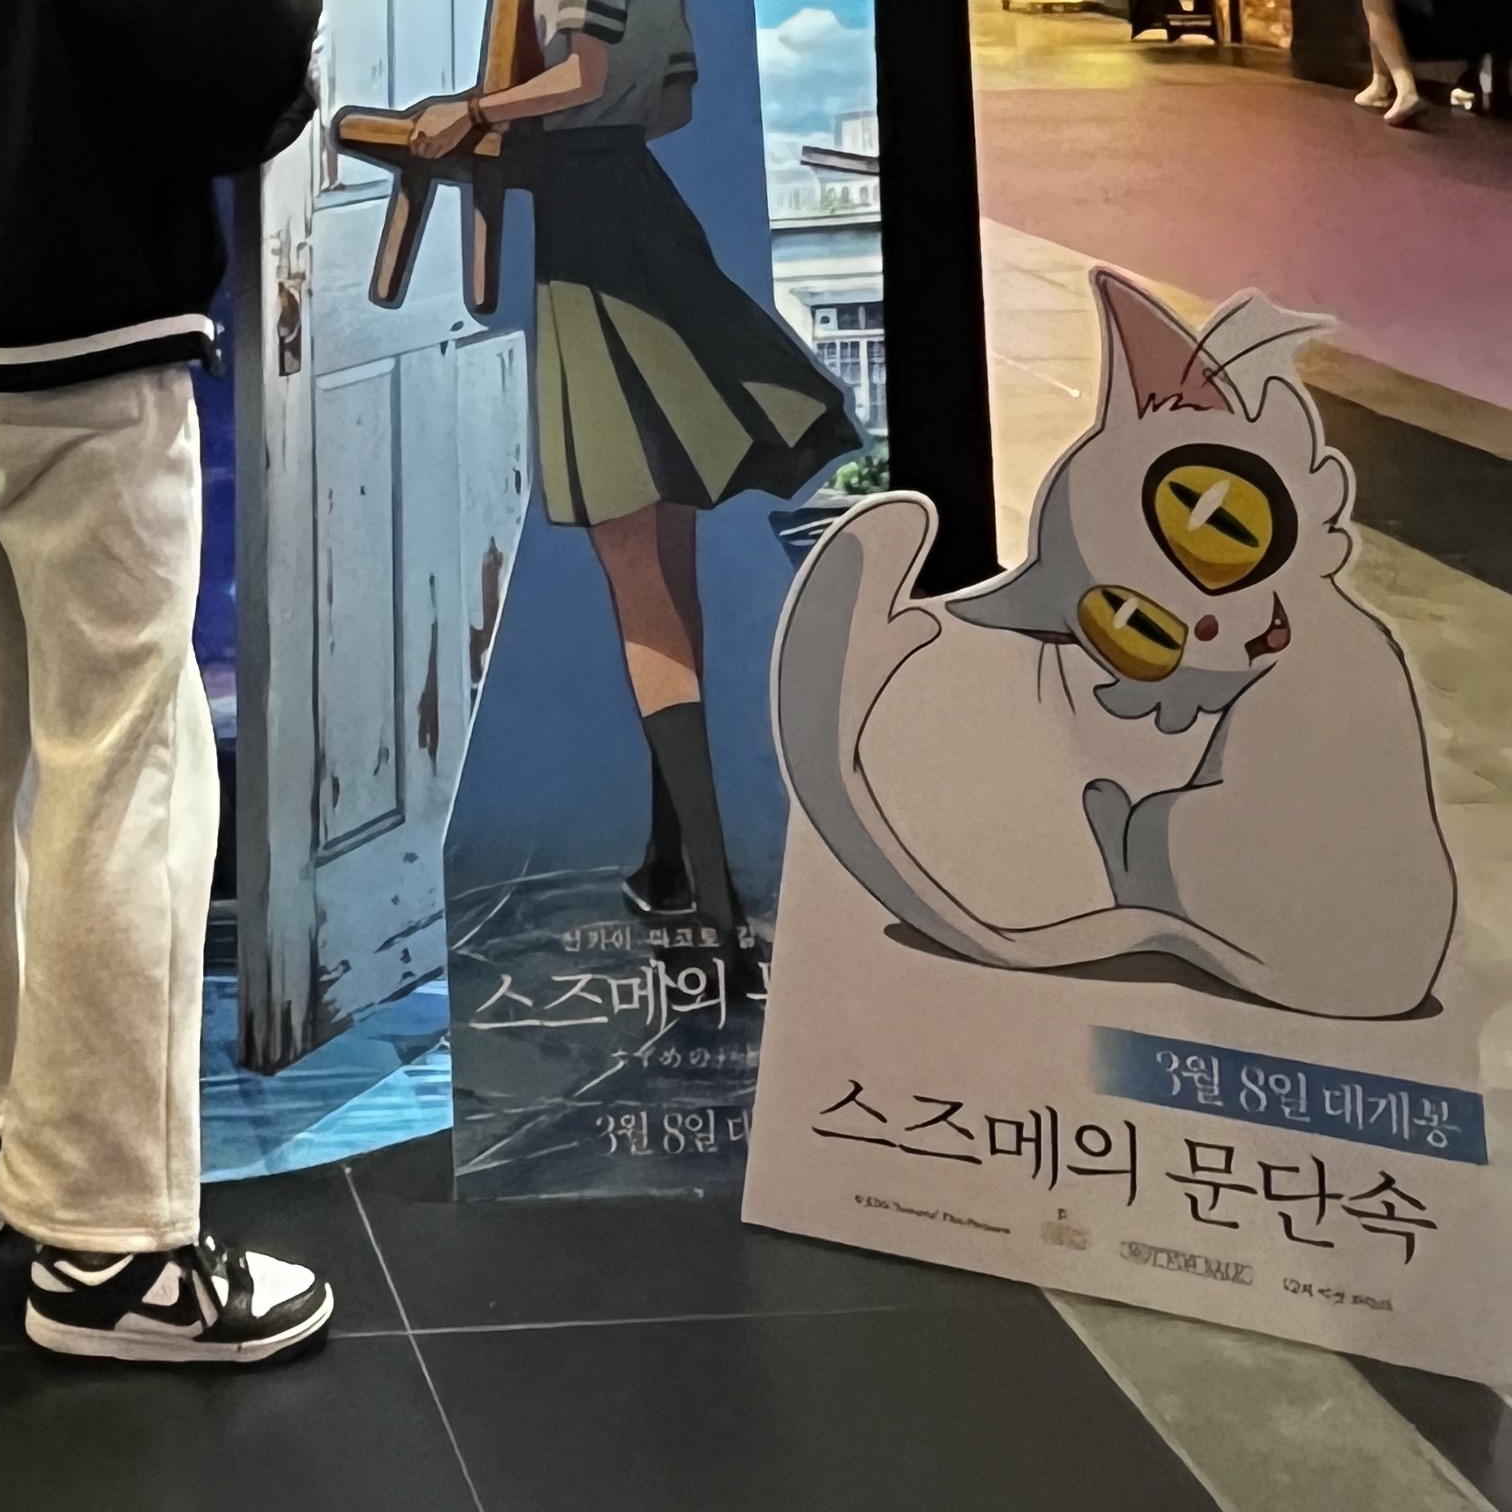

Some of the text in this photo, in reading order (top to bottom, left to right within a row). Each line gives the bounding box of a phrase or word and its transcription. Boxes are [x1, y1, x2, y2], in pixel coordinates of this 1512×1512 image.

[468, 957, 726, 1031] 스즈메의
[1155, 1050, 1462, 1148] 3월 8일 대개봉
[811, 1078, 1438, 1265] 스즈메의 문단속
